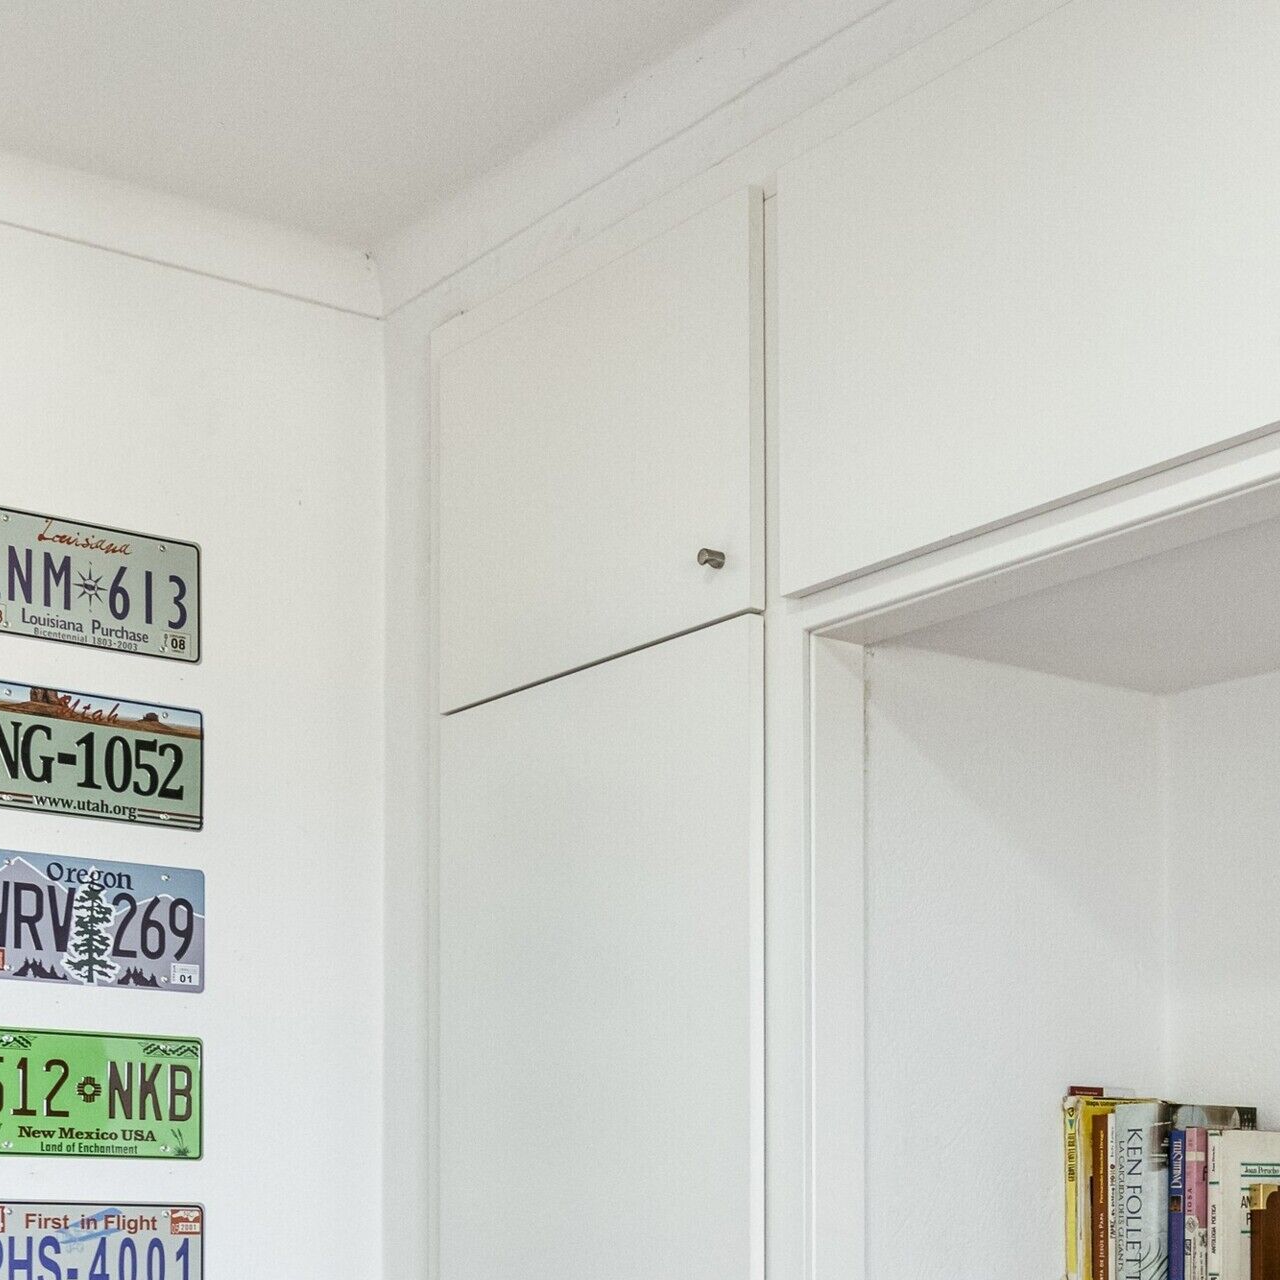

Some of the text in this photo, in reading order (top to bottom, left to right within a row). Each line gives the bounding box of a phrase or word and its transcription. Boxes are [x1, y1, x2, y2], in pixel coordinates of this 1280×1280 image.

[37, 519, 132, 555] Louisiana
[109, 566, 188, 630] 613
[22, 608, 83, 633] Louisiana
[92, 620, 149, 644] Purchase
[34, 628, 138, 652] Bicentennial 1803-2003
[171, 638, 185, 650] 08
[57, 694, 121, 723] Utah
[32, 793, 137, 821] www.utah.org
[46, 862, 134, 891] Oregon
[112, 892, 194, 961] 269
[179, 974, 192, 983] 01
[108, 1061, 192, 1121] NKB
[17, 1126, 156, 1142] New Mexico USA
[1118, 1141, 1124, 1152] LA
[40, 1142, 138, 1155] Land of Enchantment
[1126, 1128, 1143, 1175] KEN
[1170, 1139, 1183, 1189] DANIELLE STEEL
[1259, 1167, 1279, 1175] Perucho
[25, 1213, 69, 1230] First
[80, 1214, 98, 1230] in
[104, 1215, 158, 1234] Flight
